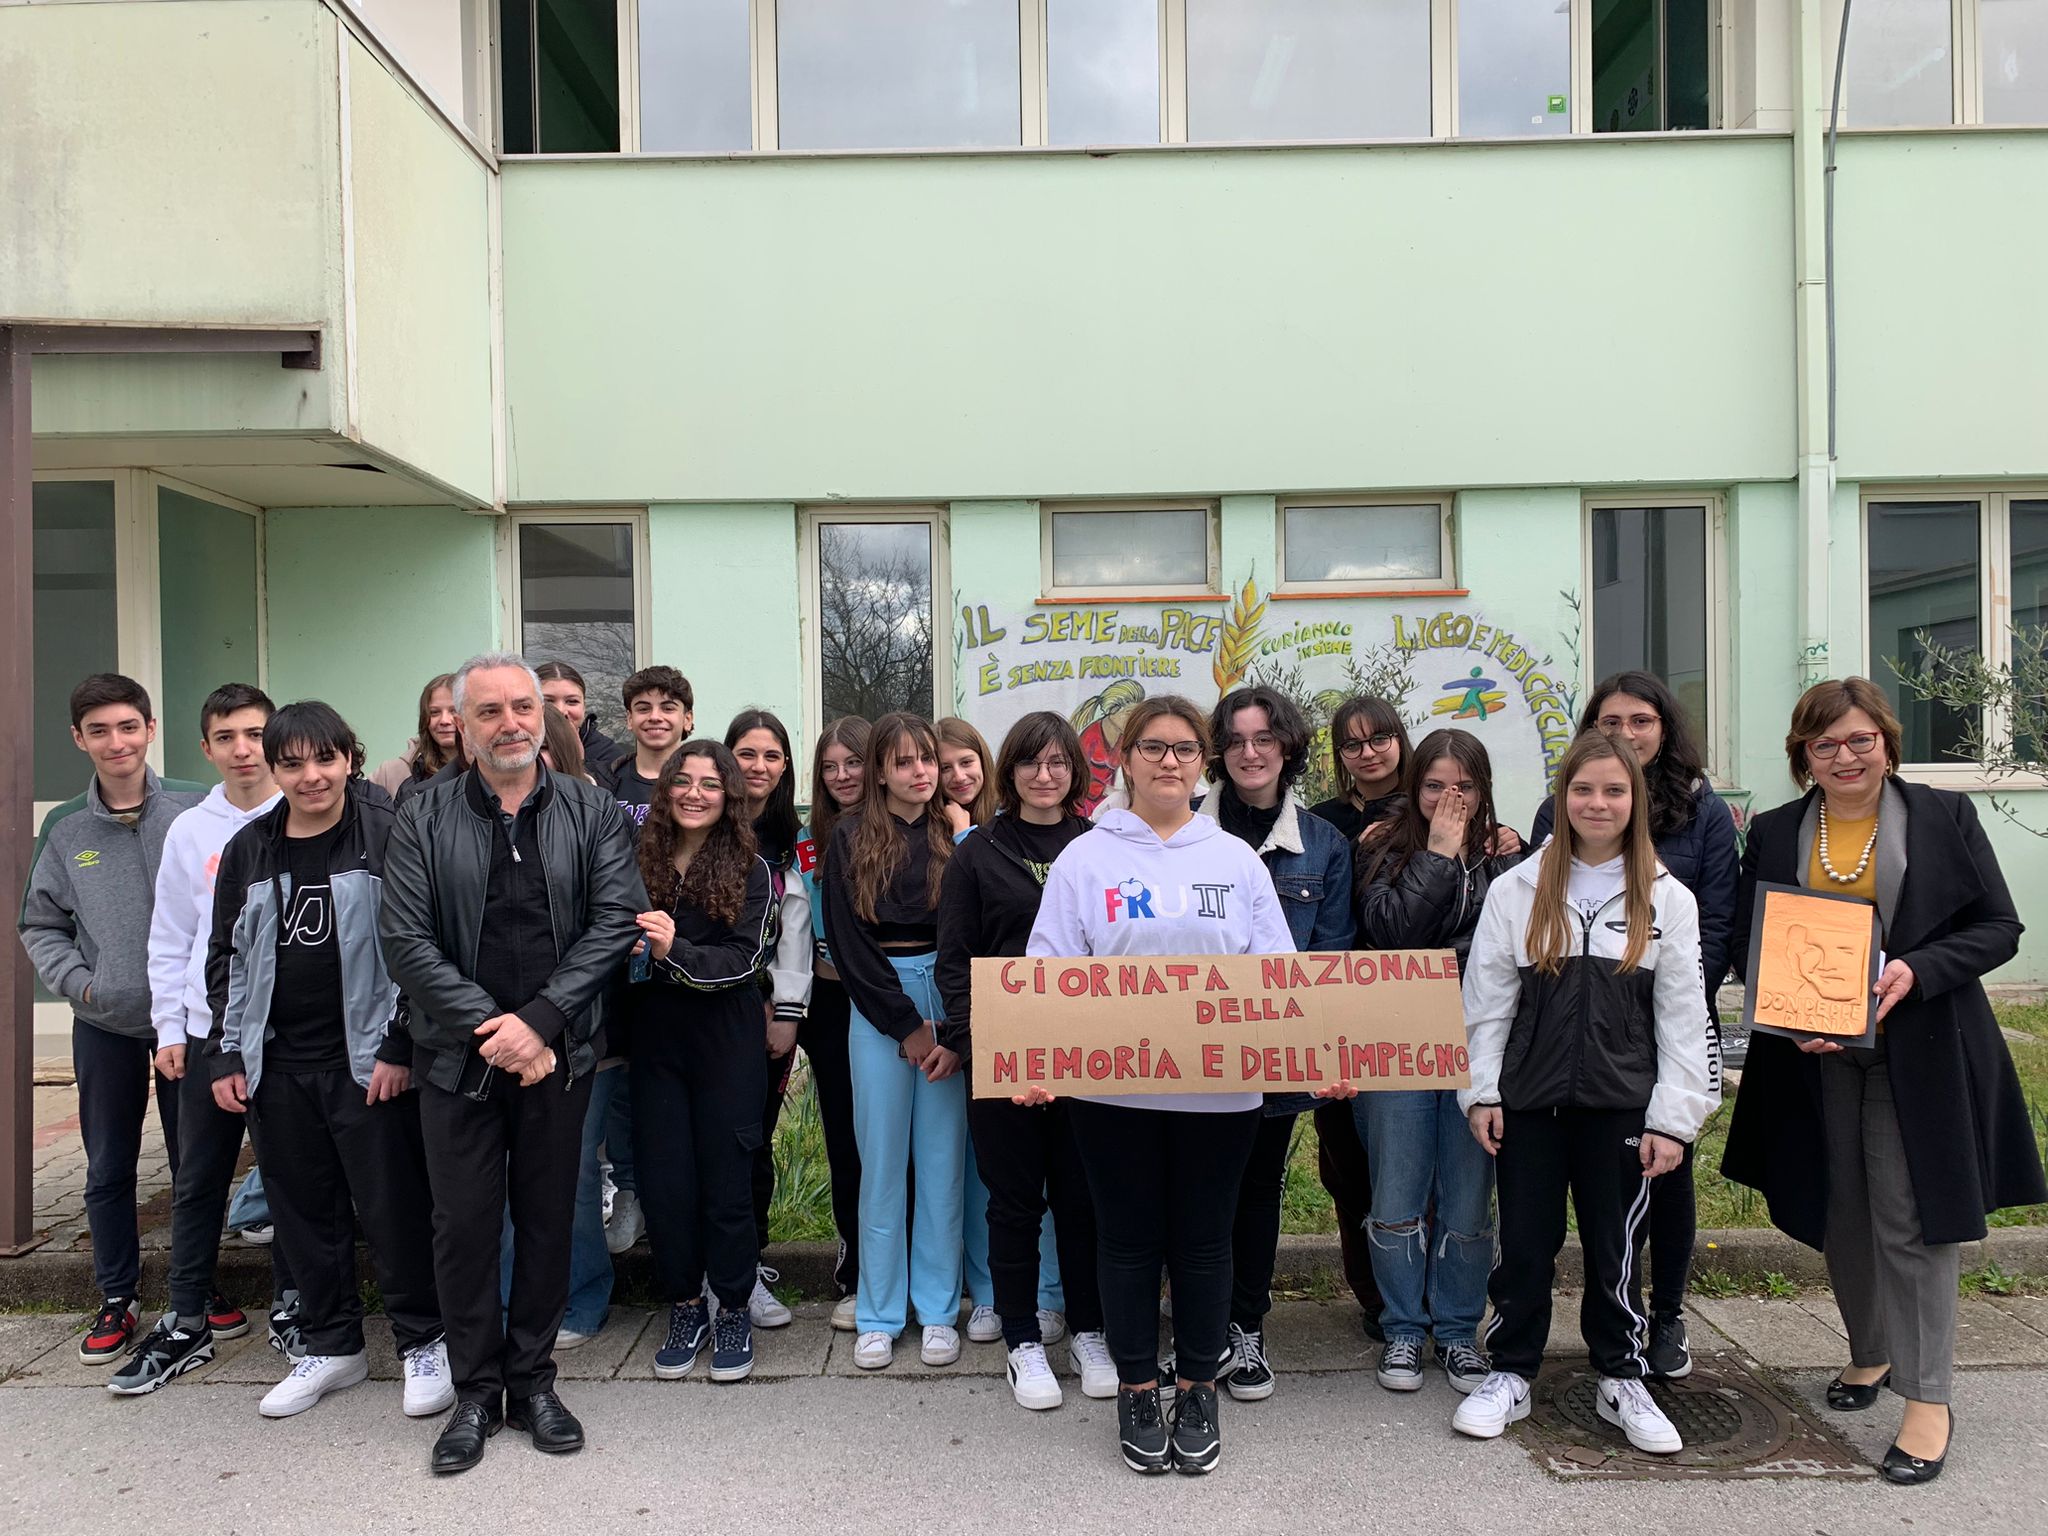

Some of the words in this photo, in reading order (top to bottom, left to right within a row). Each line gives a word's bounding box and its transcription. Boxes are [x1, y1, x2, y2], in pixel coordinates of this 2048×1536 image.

[962, 605, 1007, 649] IL
[1020, 610, 1119, 645] SEME
[1118, 625, 1159, 644] DELLA
[1157, 608, 1223, 653] PACE
[1392, 611, 1474, 651] LICEO
[979, 652, 1003, 696] È
[1007, 658, 1075, 690] SENZA
[1196, 997, 1304, 1024] DELLA
[1759, 991, 1799, 1013] DON
[1202, 1044, 1225, 1079] E
